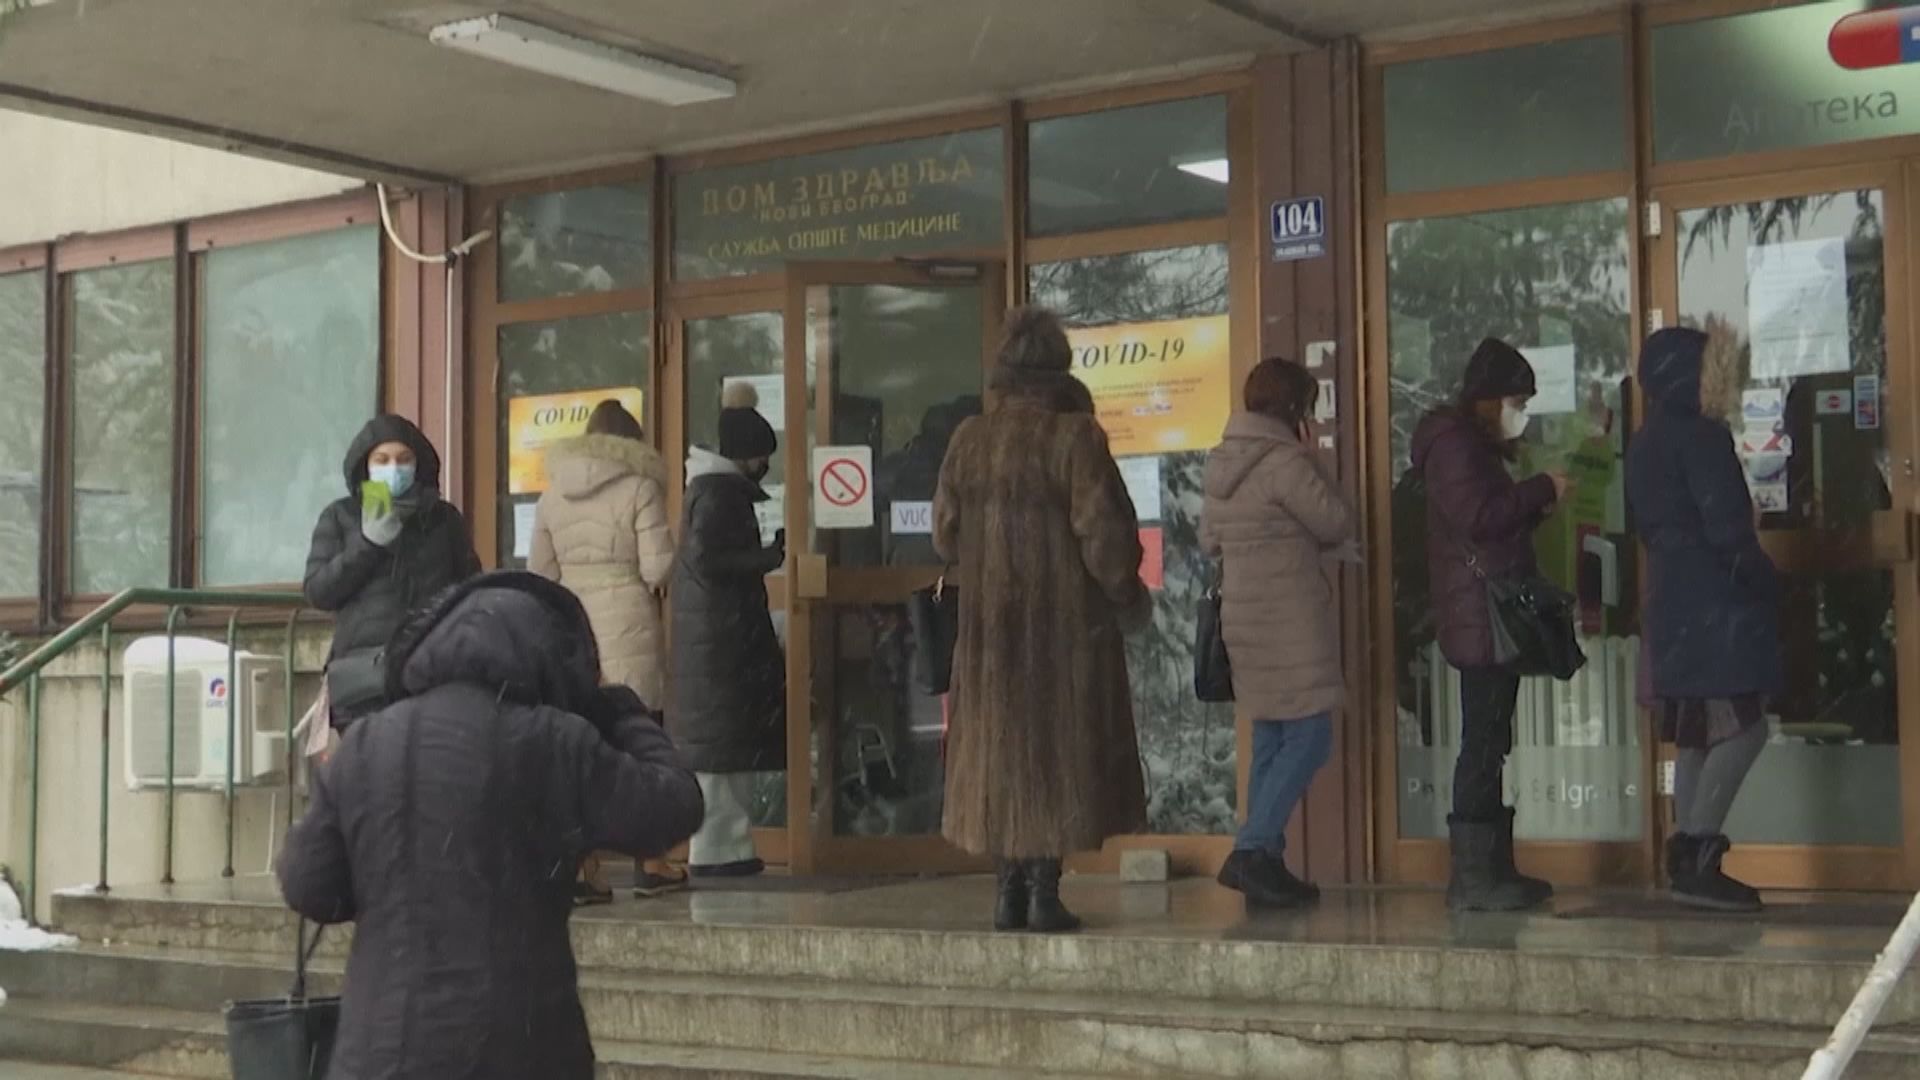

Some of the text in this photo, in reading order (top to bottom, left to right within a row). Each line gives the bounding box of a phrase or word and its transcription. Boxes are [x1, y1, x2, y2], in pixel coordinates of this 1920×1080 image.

[1723, 90, 1898, 138] Аптека
[703, 155, 975, 215] ДОМ ЗДРАВЉА
[708, 212, 961, 259] СЛУЖБА ОПШТЕ МЕДИЦИНЕ
[1277, 202, 1318, 237] 104
[533, 406, 589, 427] COVID
[898, 507, 928, 527] VUC
